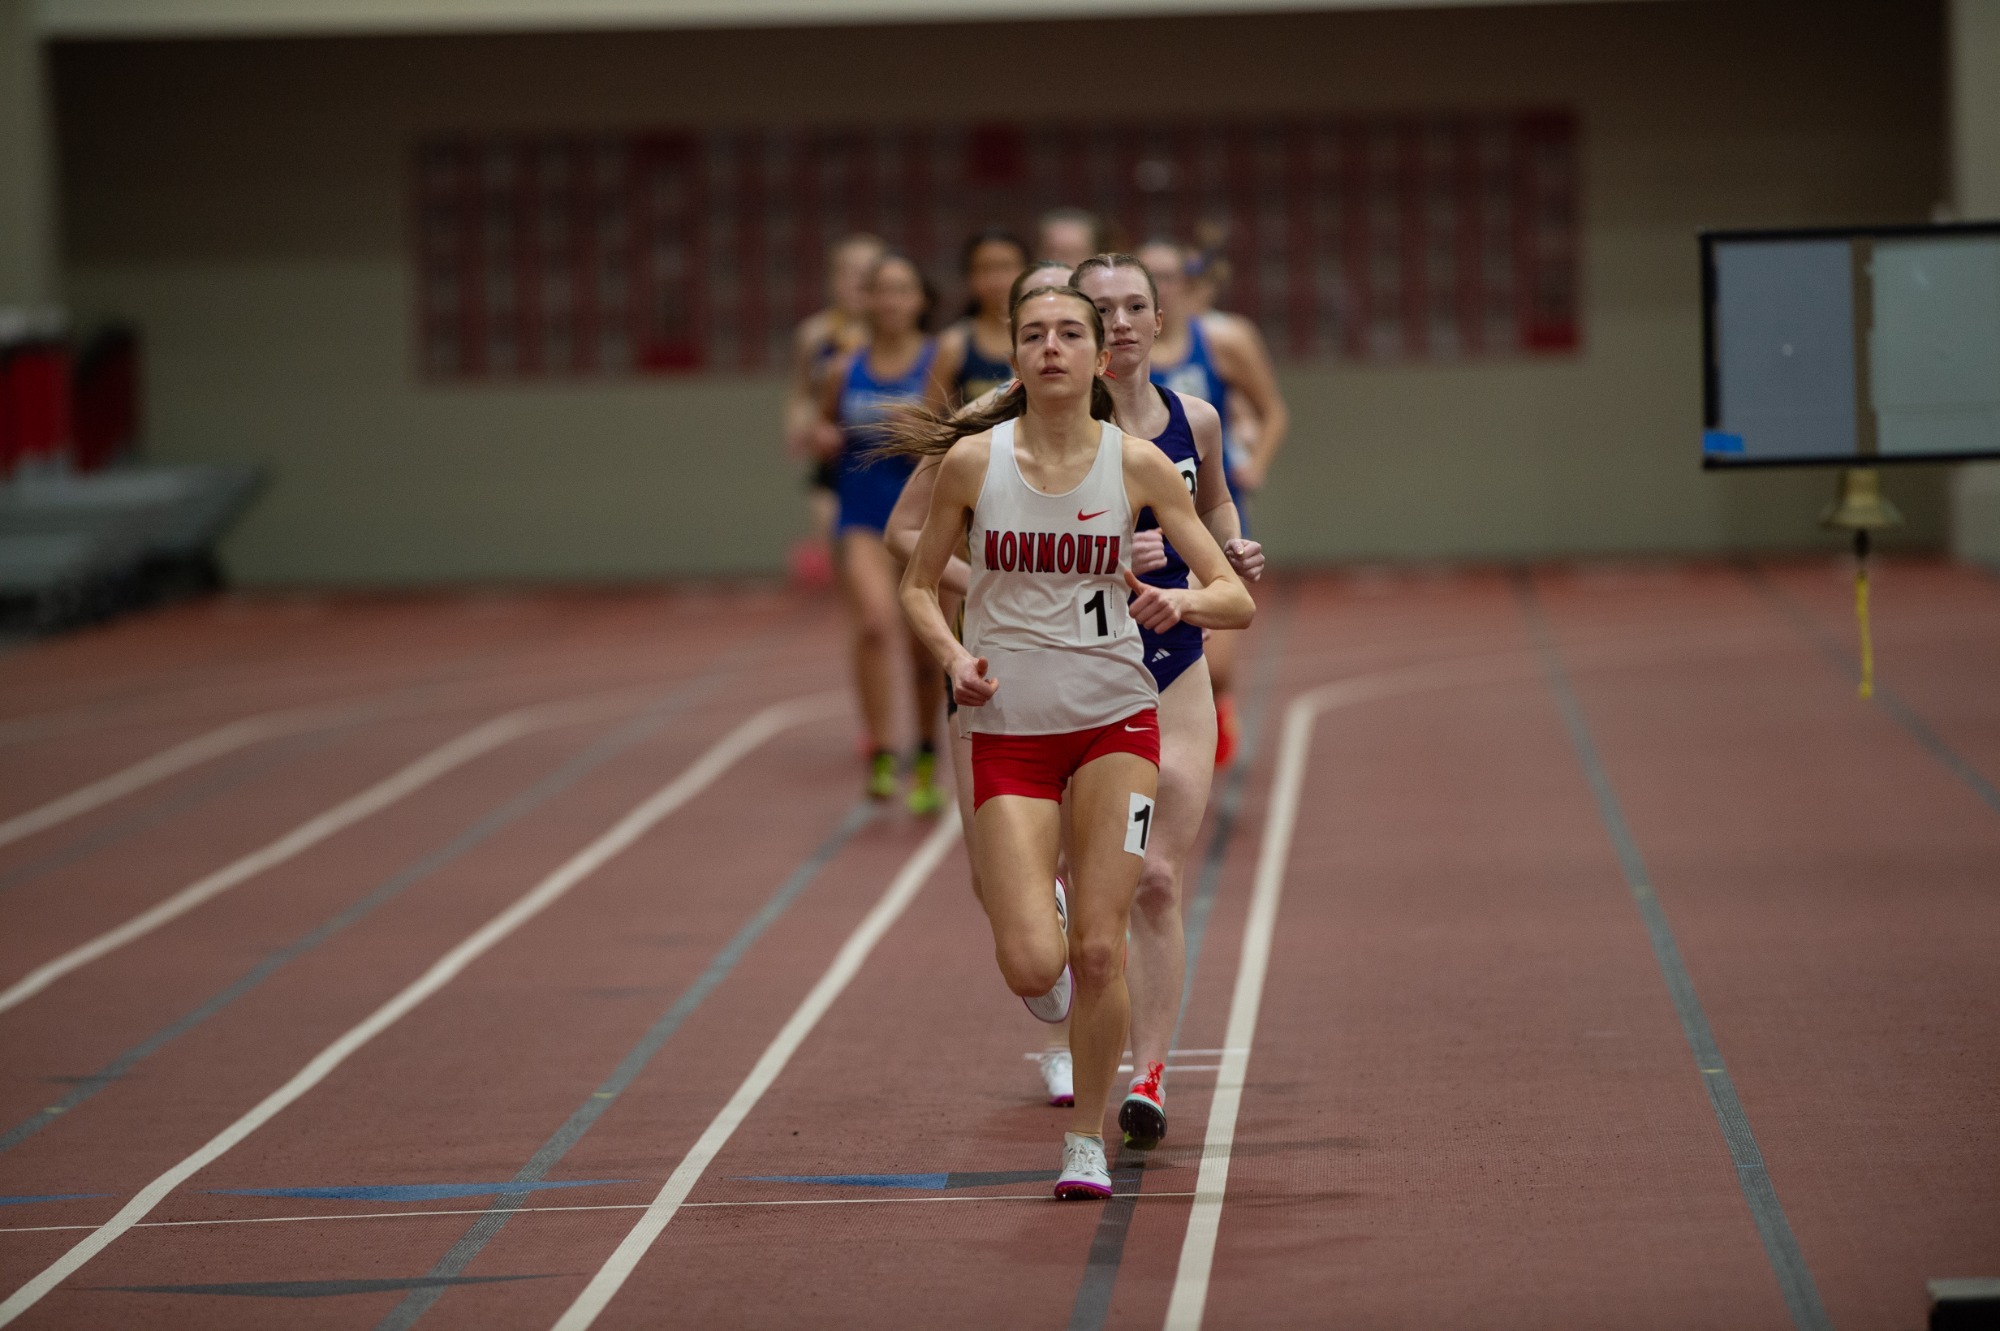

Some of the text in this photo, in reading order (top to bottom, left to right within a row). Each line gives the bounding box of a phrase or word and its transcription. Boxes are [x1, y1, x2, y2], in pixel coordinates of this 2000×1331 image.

[985, 530, 1120, 575] MONMOUTH
[1084, 590, 1108, 637] 1
[1134, 804, 1151, 851] 1
